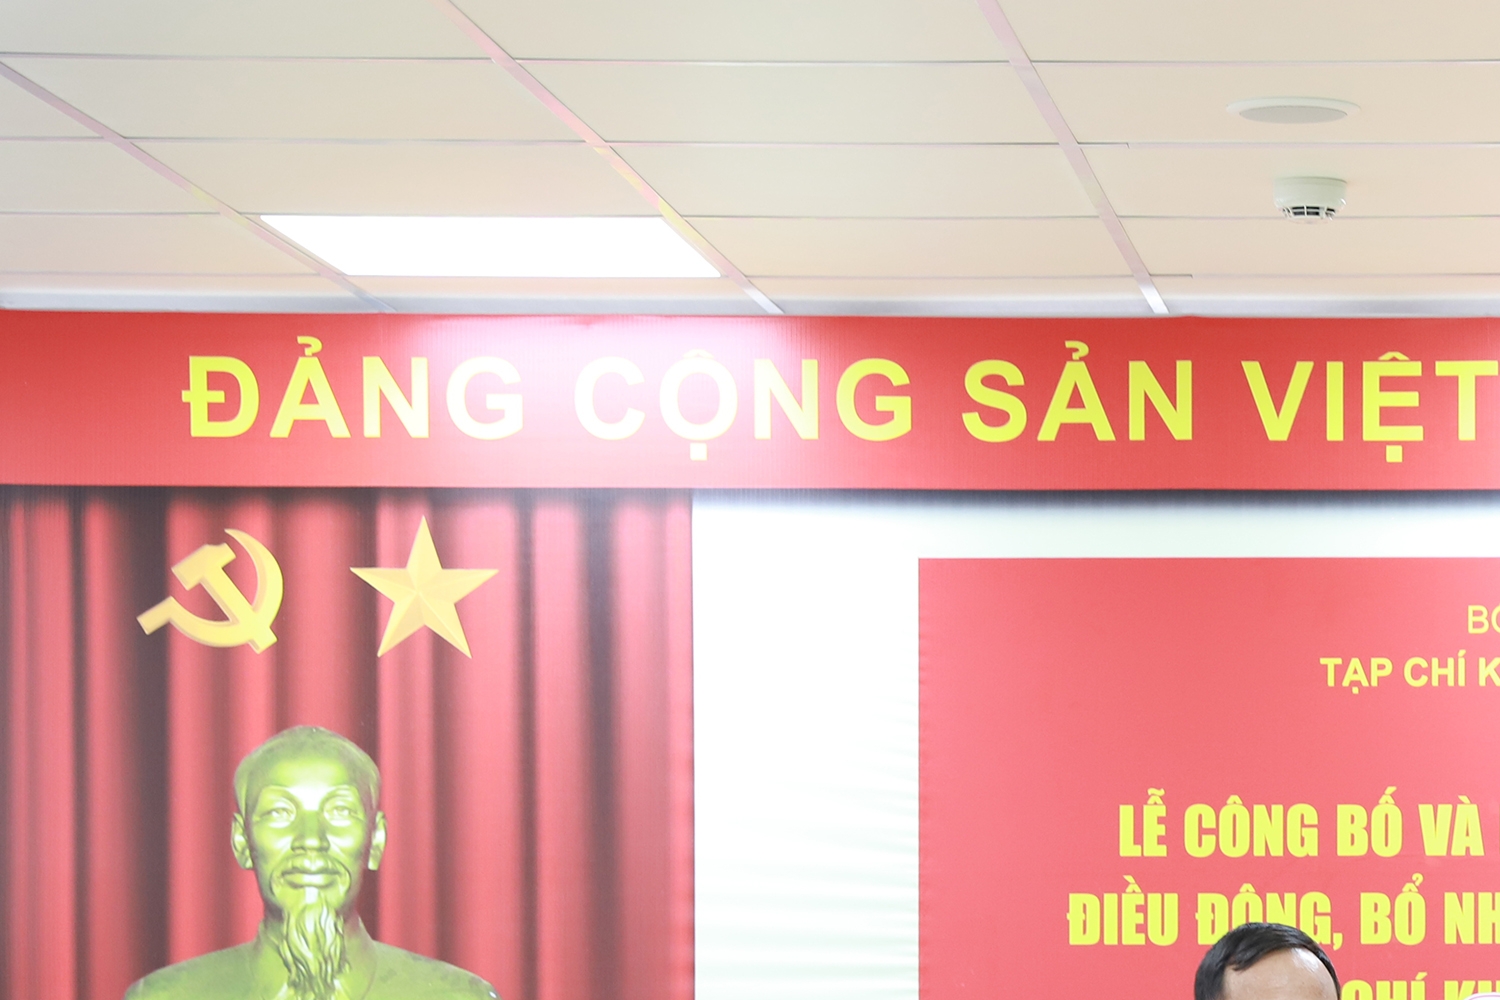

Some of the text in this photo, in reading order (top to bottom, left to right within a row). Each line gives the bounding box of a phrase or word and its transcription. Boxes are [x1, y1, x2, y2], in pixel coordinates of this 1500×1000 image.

[182, 336, 524, 439] ĐẢNG
[573, 349, 912, 461] CỘNG
[962, 340, 1193, 443] SẢN
[1241, 351, 1499, 463] VIỆT
[1319, 657, 1393, 695] TẠP
[1403, 649, 1467, 688] CHÍ
[1119, 788, 1168, 857] LỄ
[1184, 794, 1319, 858] CÔNG
[1336, 786, 1403, 857] BỐ
[1418, 795, 1485, 857] VÀ
[1066, 875, 1179, 946] ĐIỀU
[1360, 873, 1426, 946] BỔ
